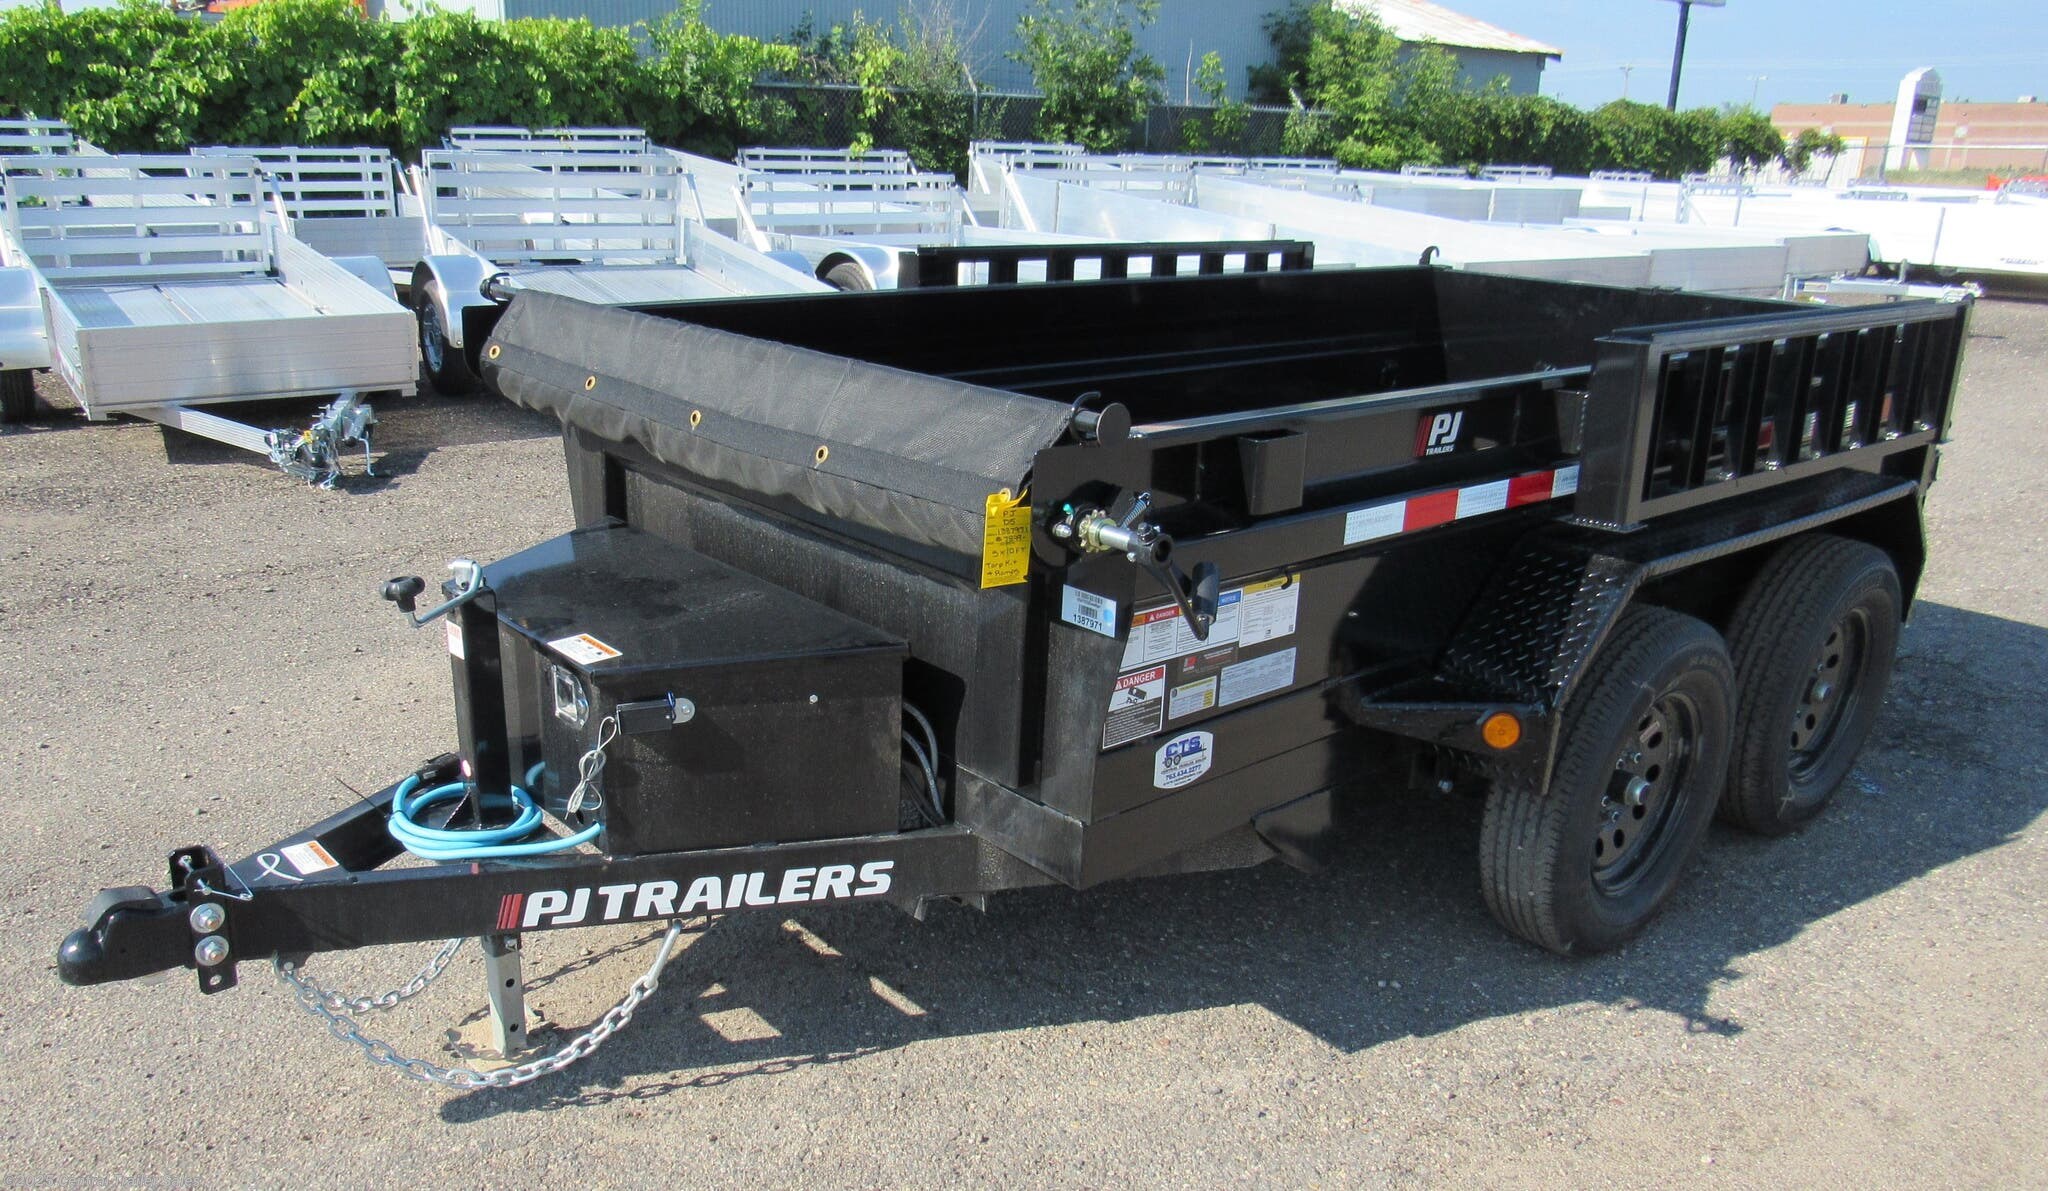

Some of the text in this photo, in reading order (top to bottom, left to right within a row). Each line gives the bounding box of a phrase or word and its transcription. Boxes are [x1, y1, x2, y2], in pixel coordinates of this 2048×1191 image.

[1428, 411, 1463, 446] PJ
[1003, 509, 1016, 517] PJ
[1073, 614, 1103, 631] 1387971
[1123, 671, 1156, 688] DANGER
[1166, 735, 1201, 757] CTS
[521, 860, 895, 928] PJ TRAILERS
